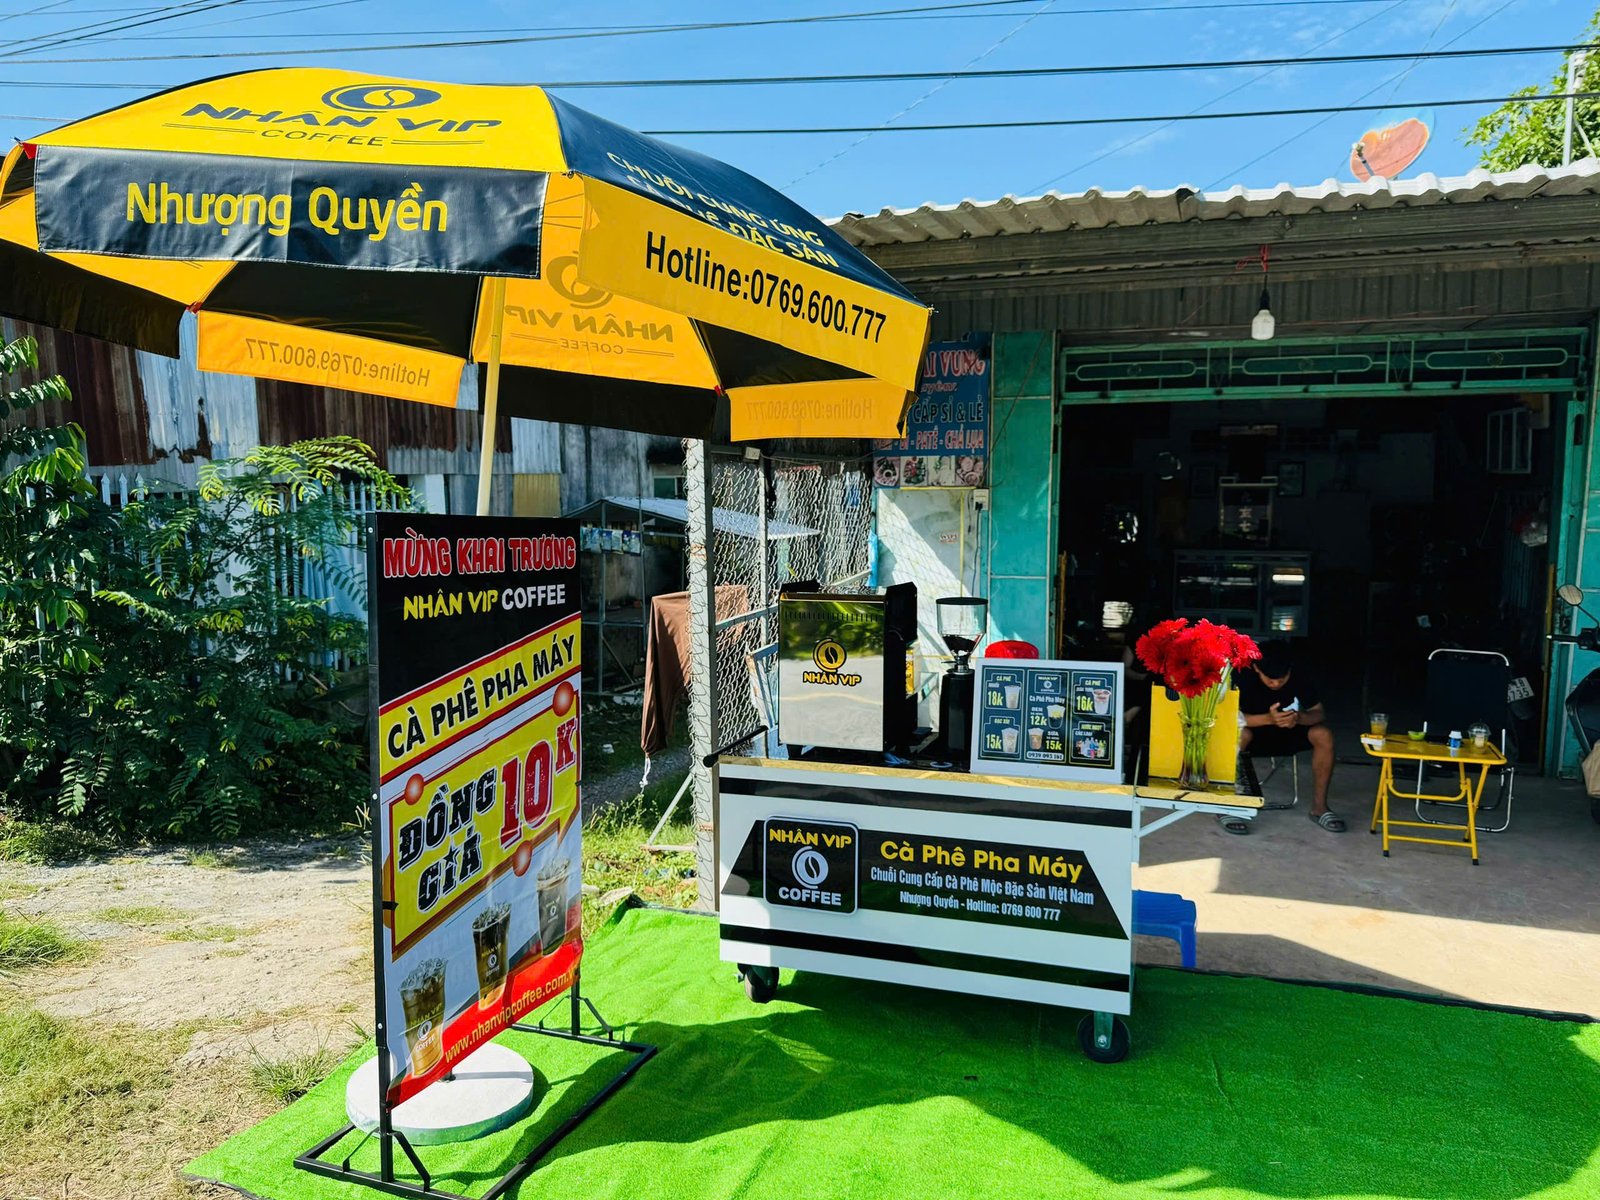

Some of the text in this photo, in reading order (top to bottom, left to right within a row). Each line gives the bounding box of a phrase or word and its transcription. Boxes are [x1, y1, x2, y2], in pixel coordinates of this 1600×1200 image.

[181, 103, 502, 133] NHÂN VIP
[261, 129, 387, 147] COFFEE
[126, 182, 448, 241] Nhượng Quyền
[607, 151, 826, 248] CHUỖI CUNG ỨNG
[646, 230, 887, 344] Hotline:0769.600.777
[956, 402, 966, 422] &
[383, 526, 452, 578] MỪNG
[457, 535, 505, 575] KHAI
[403, 583, 566, 621] NHÂN VIP COFFEE
[839, 674, 862, 686] VIP
[388, 633, 575, 758] CÀ PHÊ PHA MÁY
[988, 690, 1004, 706] 18k
[1076, 695, 1094, 712] 16k
[1030, 715, 1048, 726] 12k
[986, 733, 1003, 750] 15k
[1045, 740, 1062, 751] 15k
[398, 767, 498, 872] ĐỒNG
[769, 828, 852, 849] NHÂN VIP
[418, 825, 484, 912] GIÁ
[880, 840, 1083, 884] Cà Phê Pha Máy
[778, 886, 842, 906] COFFEE
[870, 866, 1095, 906] Chuỗi Cung Cấp Cà Phê Mộc Đặc Sản Việt Nam
[900, 890, 932, 908] Nhượng
[966, 898, 1000, 915] Hotline:
[1001, 904, 1023, 917] 0769
[1025, 905, 1042, 919] 600
[1043, 907, 1061, 921] 777
